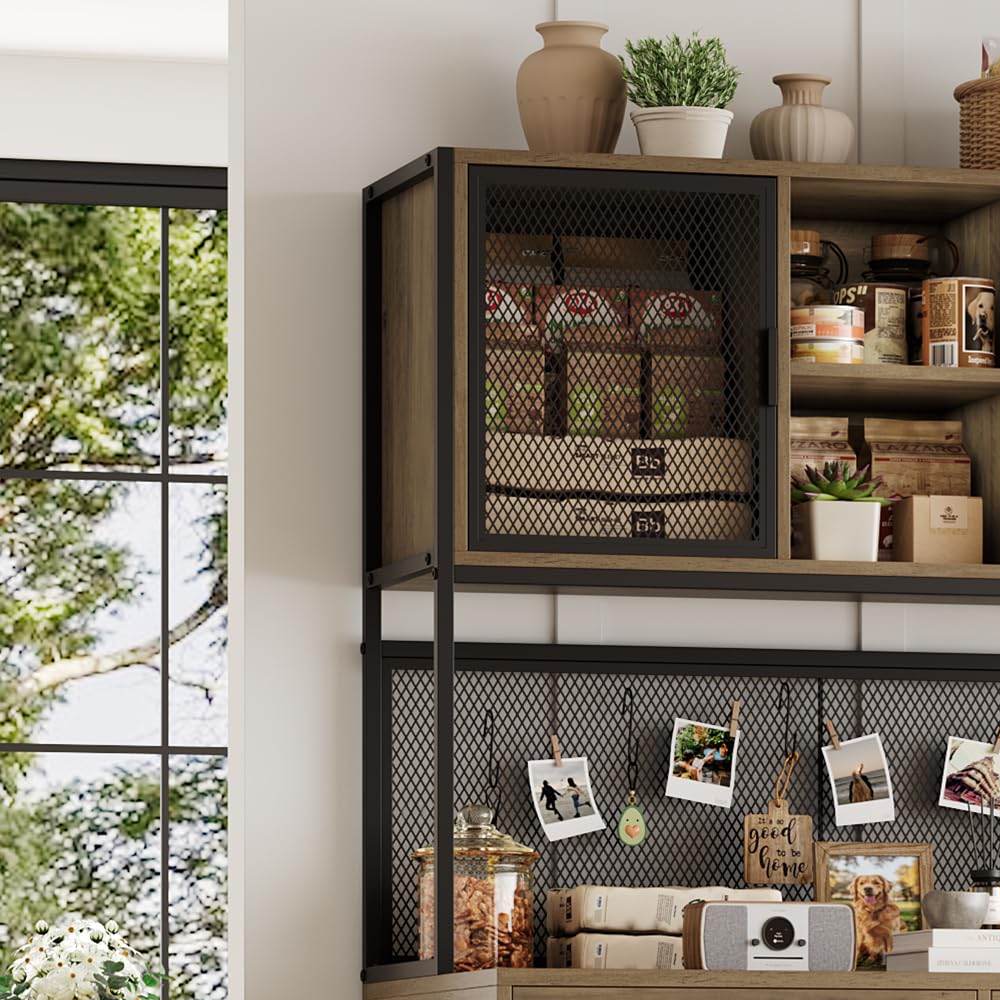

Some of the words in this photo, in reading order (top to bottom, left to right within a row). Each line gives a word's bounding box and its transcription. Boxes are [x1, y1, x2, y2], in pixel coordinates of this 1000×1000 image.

[748, 818, 797, 854] good
[776, 848, 786, 857] to
[791, 848, 801, 857] be
[759, 845, 808, 879] home
